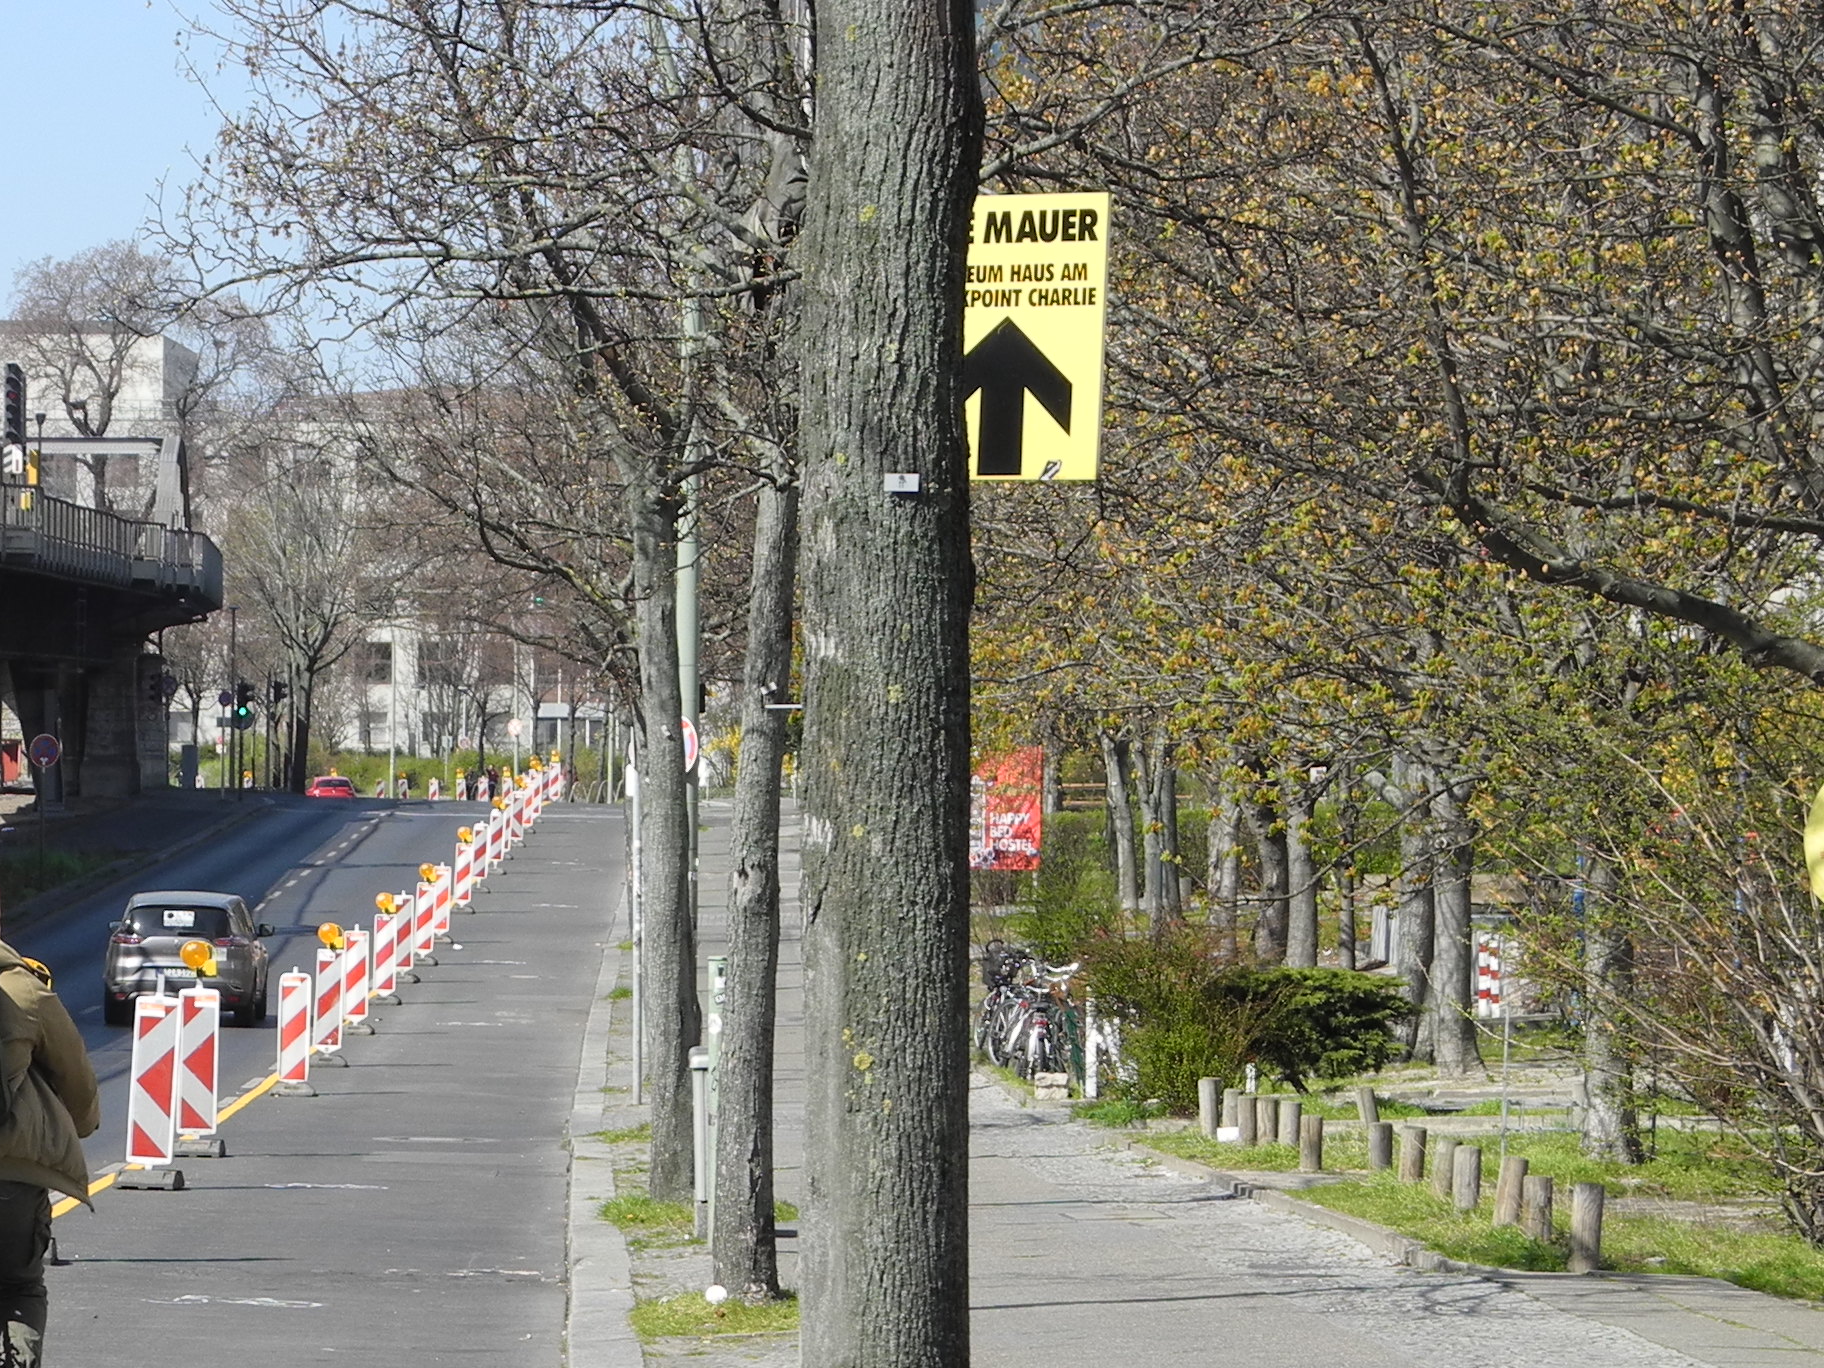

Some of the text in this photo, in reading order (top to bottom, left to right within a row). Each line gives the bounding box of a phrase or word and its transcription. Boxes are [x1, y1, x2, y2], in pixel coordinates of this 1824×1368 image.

[983, 209, 1099, 244] MAUER
[1010, 263, 1055, 282] HAUS
[1060, 263, 1088, 281] AM
[1028, 287, 1097, 307] CHARLIE
[989, 812, 1031, 825] HAPPY
[989, 826, 1013, 838] BED
